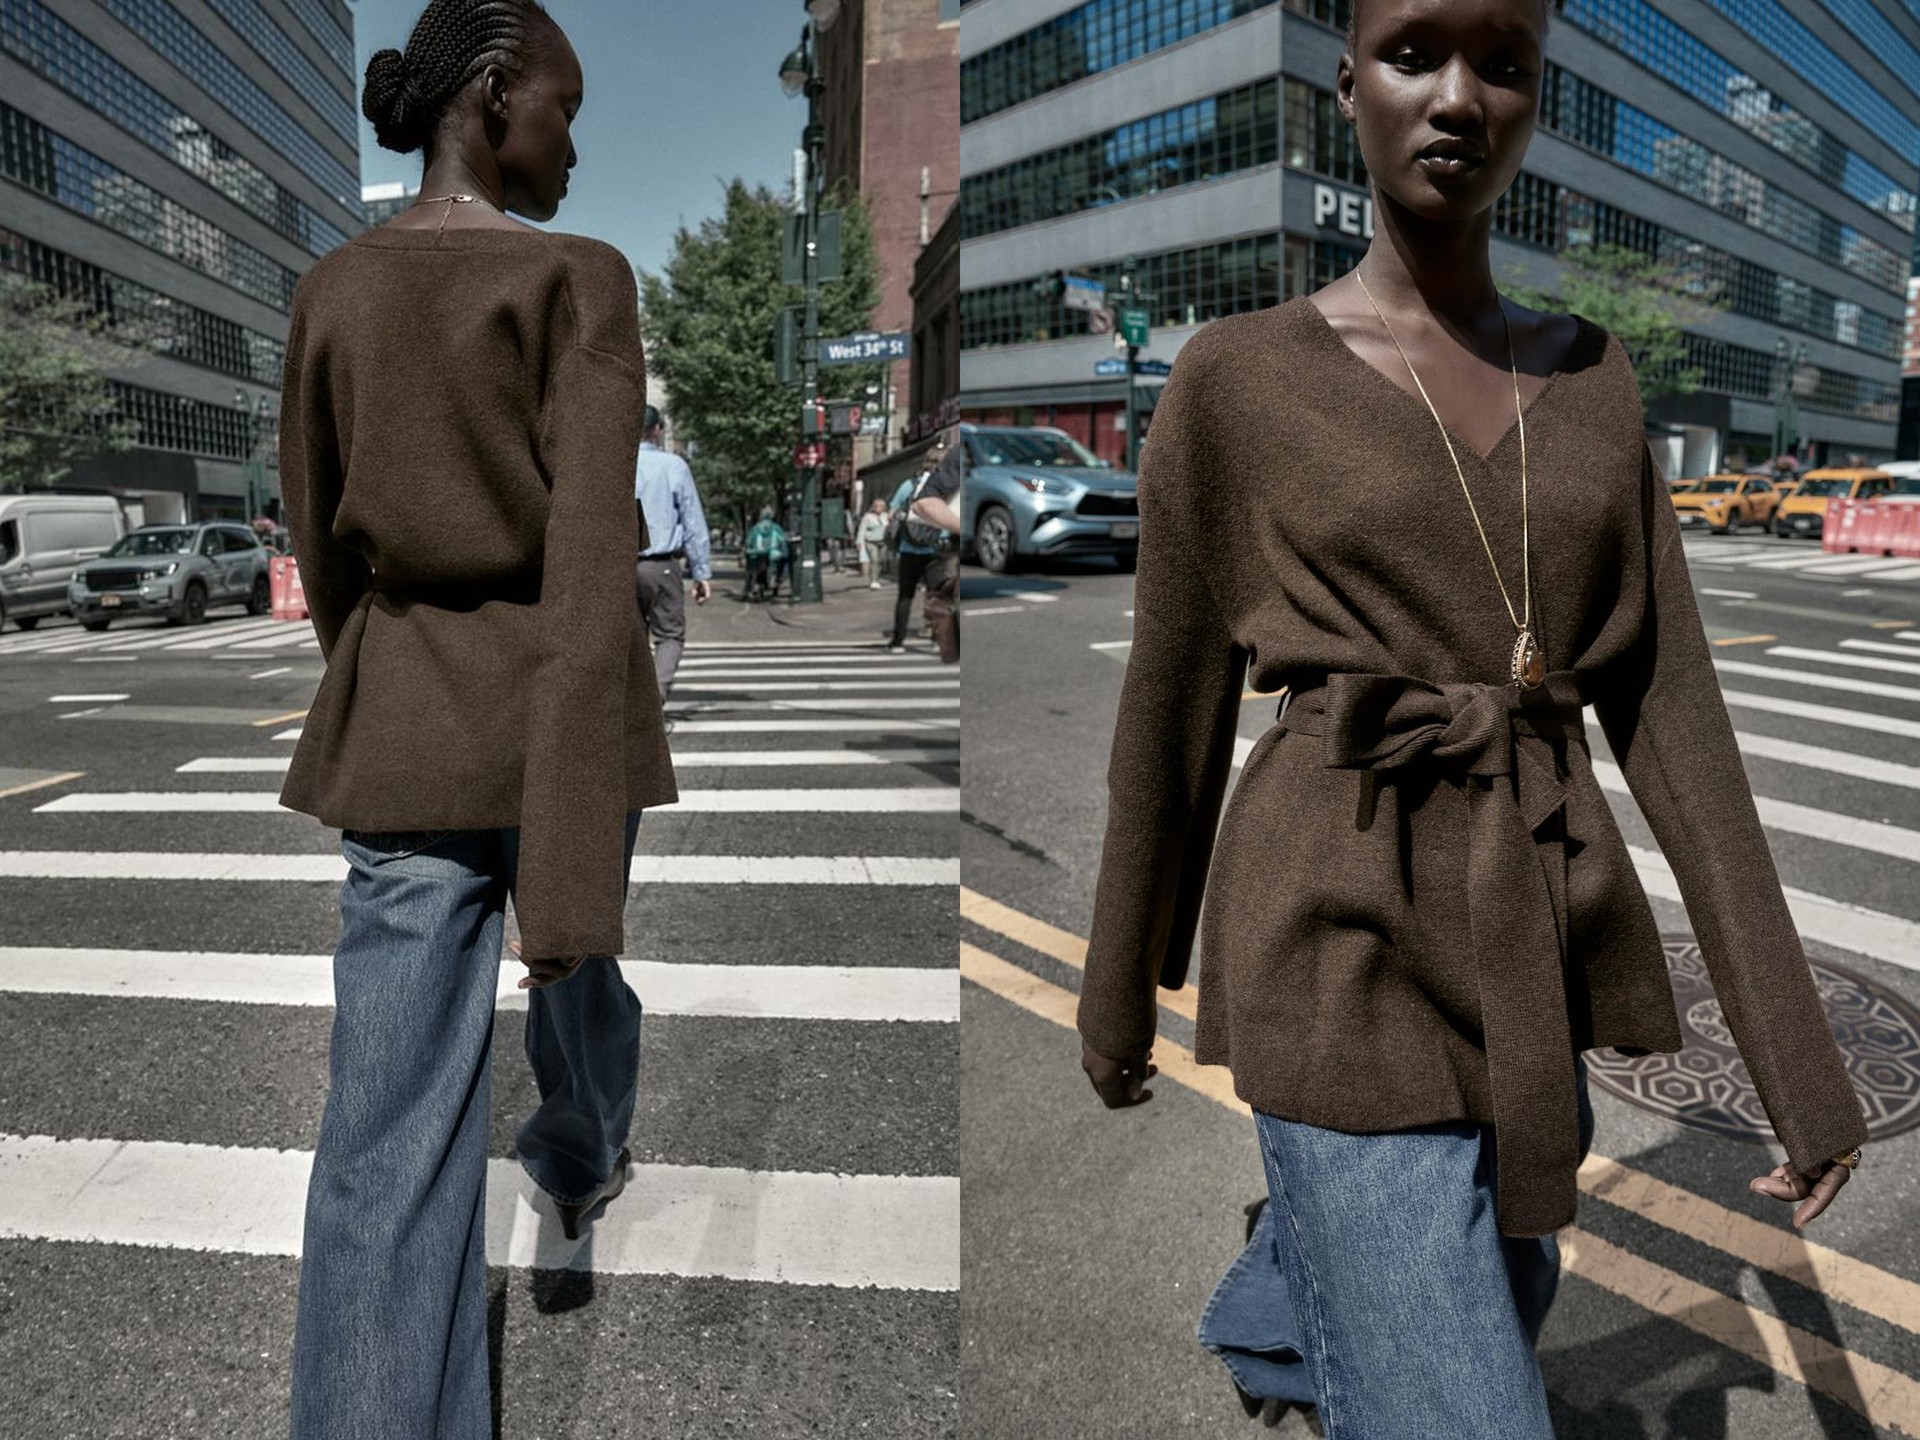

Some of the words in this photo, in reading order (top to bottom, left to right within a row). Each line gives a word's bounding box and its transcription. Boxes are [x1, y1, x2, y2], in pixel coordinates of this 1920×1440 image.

[829, 344, 862, 359] West
[863, 340, 888, 357] 34th
[889, 339, 904, 354] St
